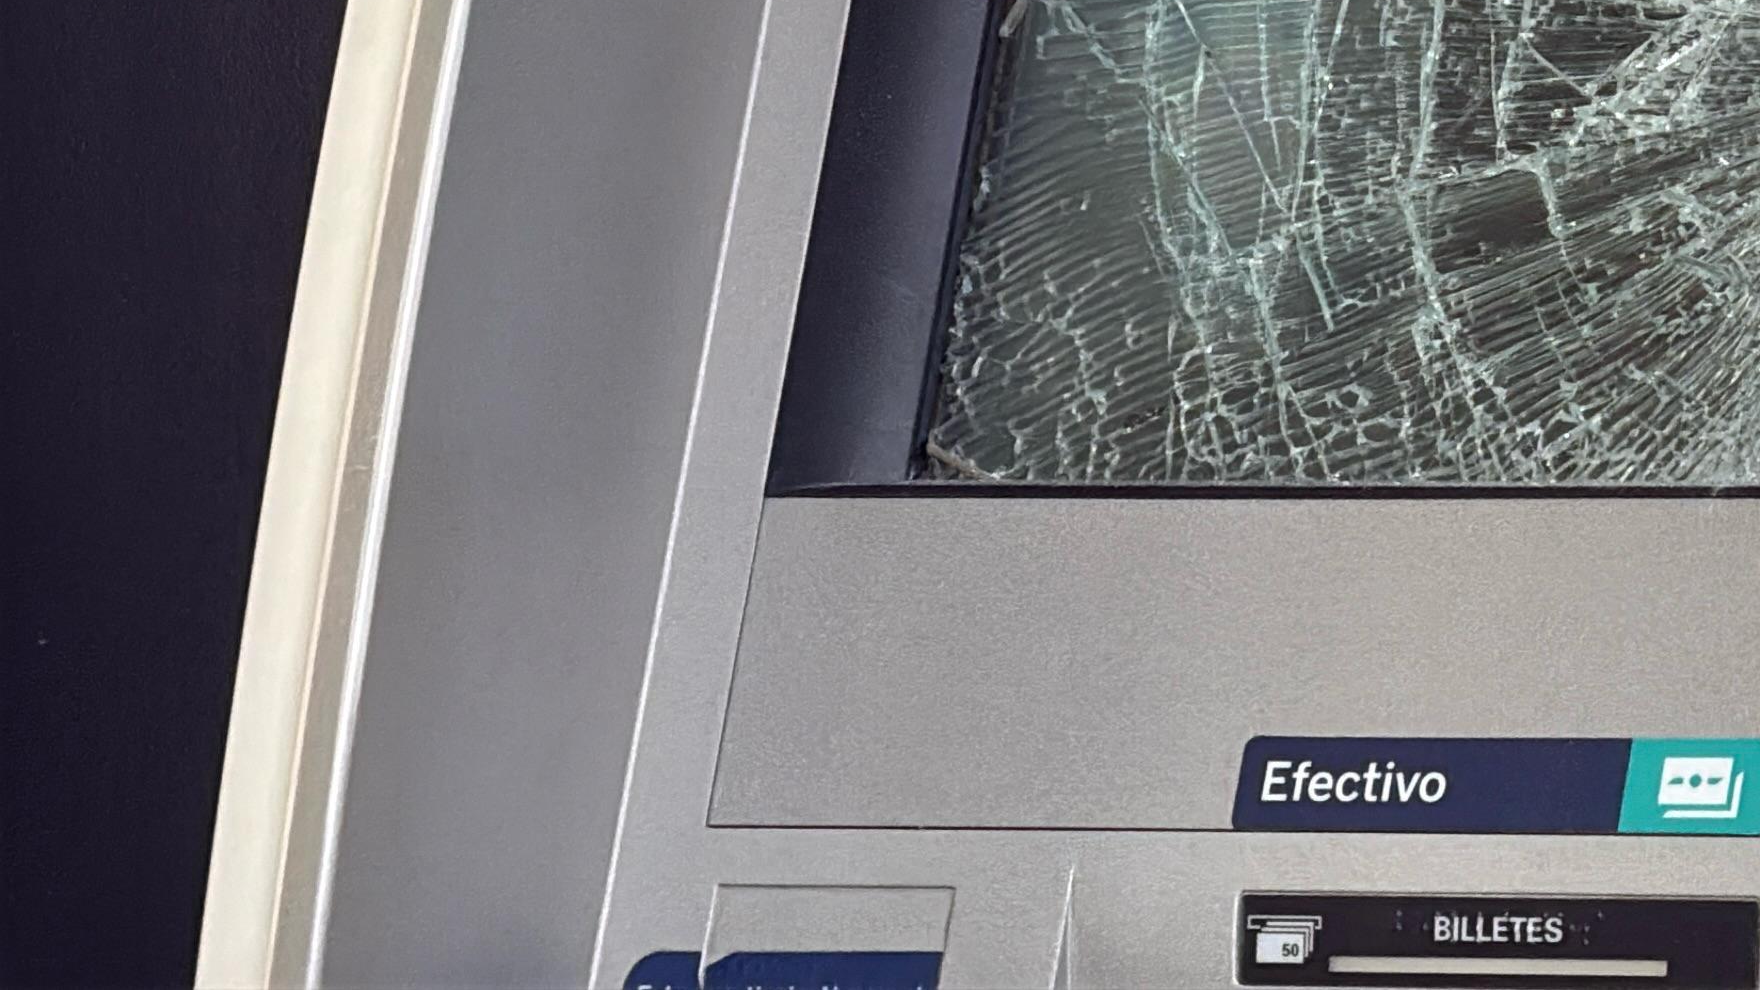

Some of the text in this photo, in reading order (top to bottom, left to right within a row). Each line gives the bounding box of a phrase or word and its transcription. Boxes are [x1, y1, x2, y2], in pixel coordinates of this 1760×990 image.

[1260, 760, 1447, 803] Efectivo
[1434, 915, 1563, 943] BILLETES
[1282, 943, 1299, 958] 50
